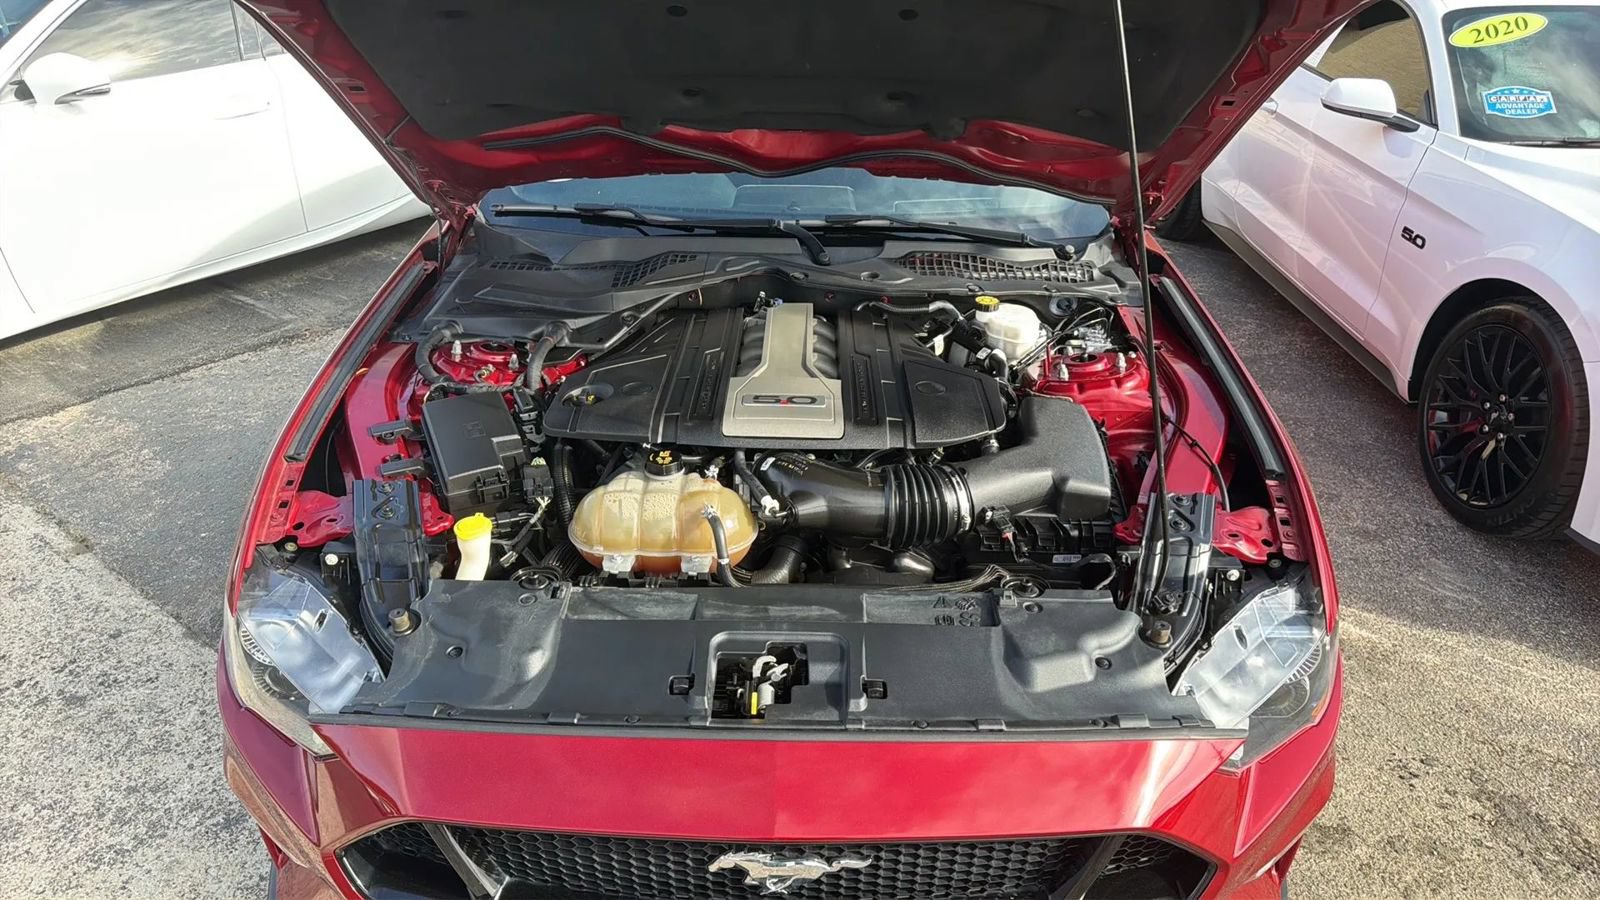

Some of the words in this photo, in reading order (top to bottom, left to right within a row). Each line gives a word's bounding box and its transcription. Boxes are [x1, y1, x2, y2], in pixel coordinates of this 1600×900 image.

[1470, 16, 1528, 43] 2020
[1401, 226, 1426, 249] 5.0
[752, 395, 818, 405] 5.0
